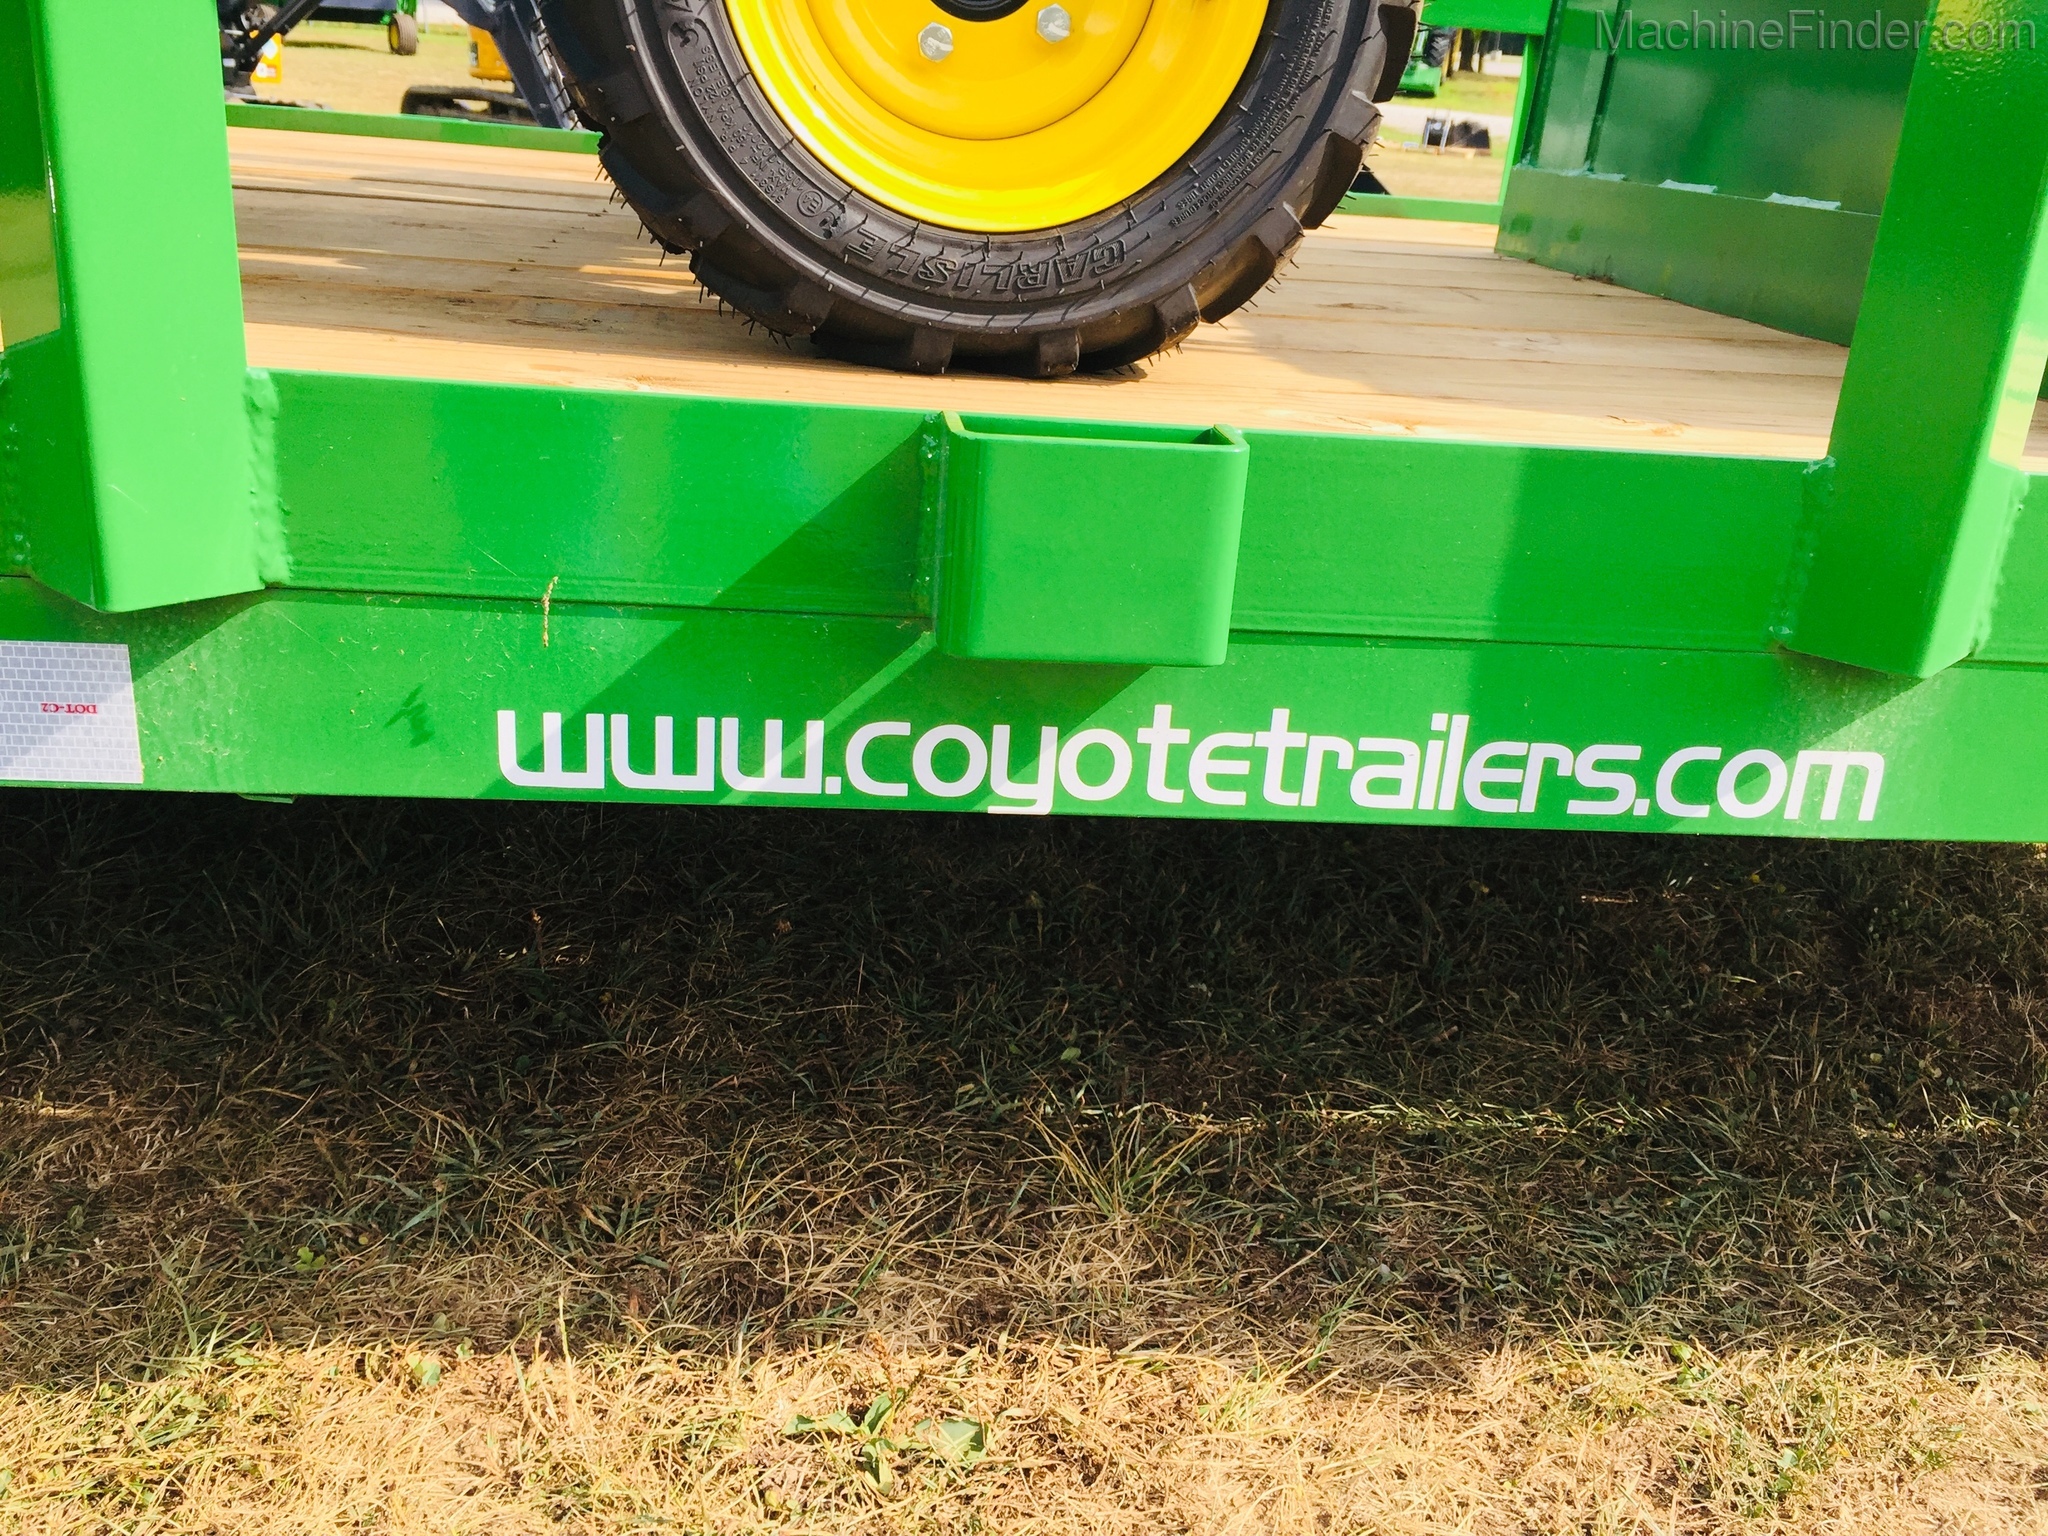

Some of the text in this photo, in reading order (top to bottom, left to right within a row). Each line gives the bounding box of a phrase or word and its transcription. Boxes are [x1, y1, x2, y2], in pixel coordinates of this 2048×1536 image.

[684, 77, 718, 124] NYLON
[698, 43, 743, 115] TUBELESS
[714, 101, 737, 131] KPA
[847, 228, 1127, 290] CARLISLE
[40, 702, 98, 714] DOT-C2
[497, 704, 1885, 822] www.coyotetrailers.com
